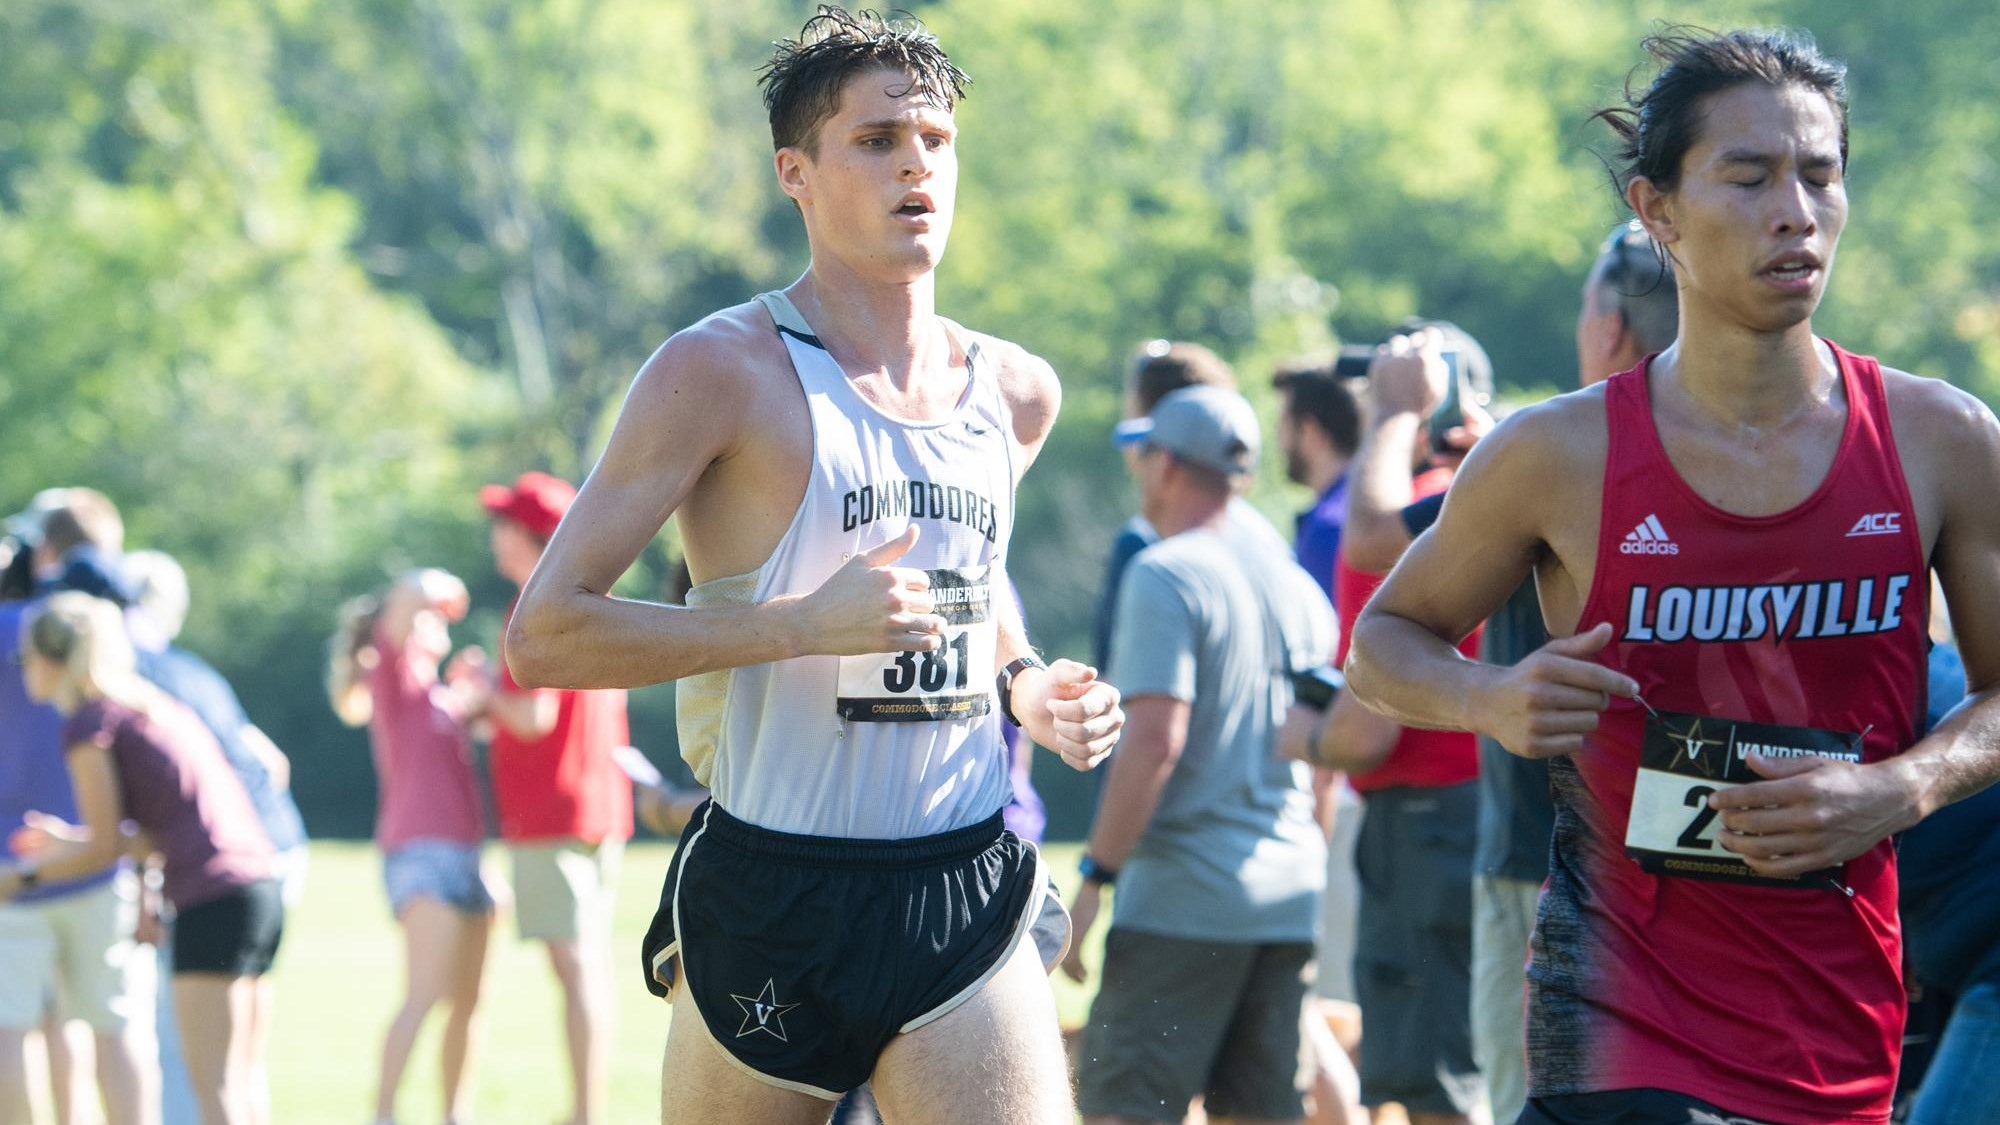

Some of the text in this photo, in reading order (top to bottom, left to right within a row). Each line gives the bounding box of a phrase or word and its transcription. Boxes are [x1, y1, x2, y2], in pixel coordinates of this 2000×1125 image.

[843, 480, 997, 543] COMMODORES
[1850, 512, 1902, 533] ACC
[1619, 540, 1680, 555] adidas
[1620, 573, 1911, 646] LOUISVILLE
[883, 631, 969, 693] 381
[872, 703, 939, 714] COMMODORE
[1686, 739, 1703, 760] V
[1664, 859, 1747, 875] COMMODORE
[755, 1003, 775, 1025] V
